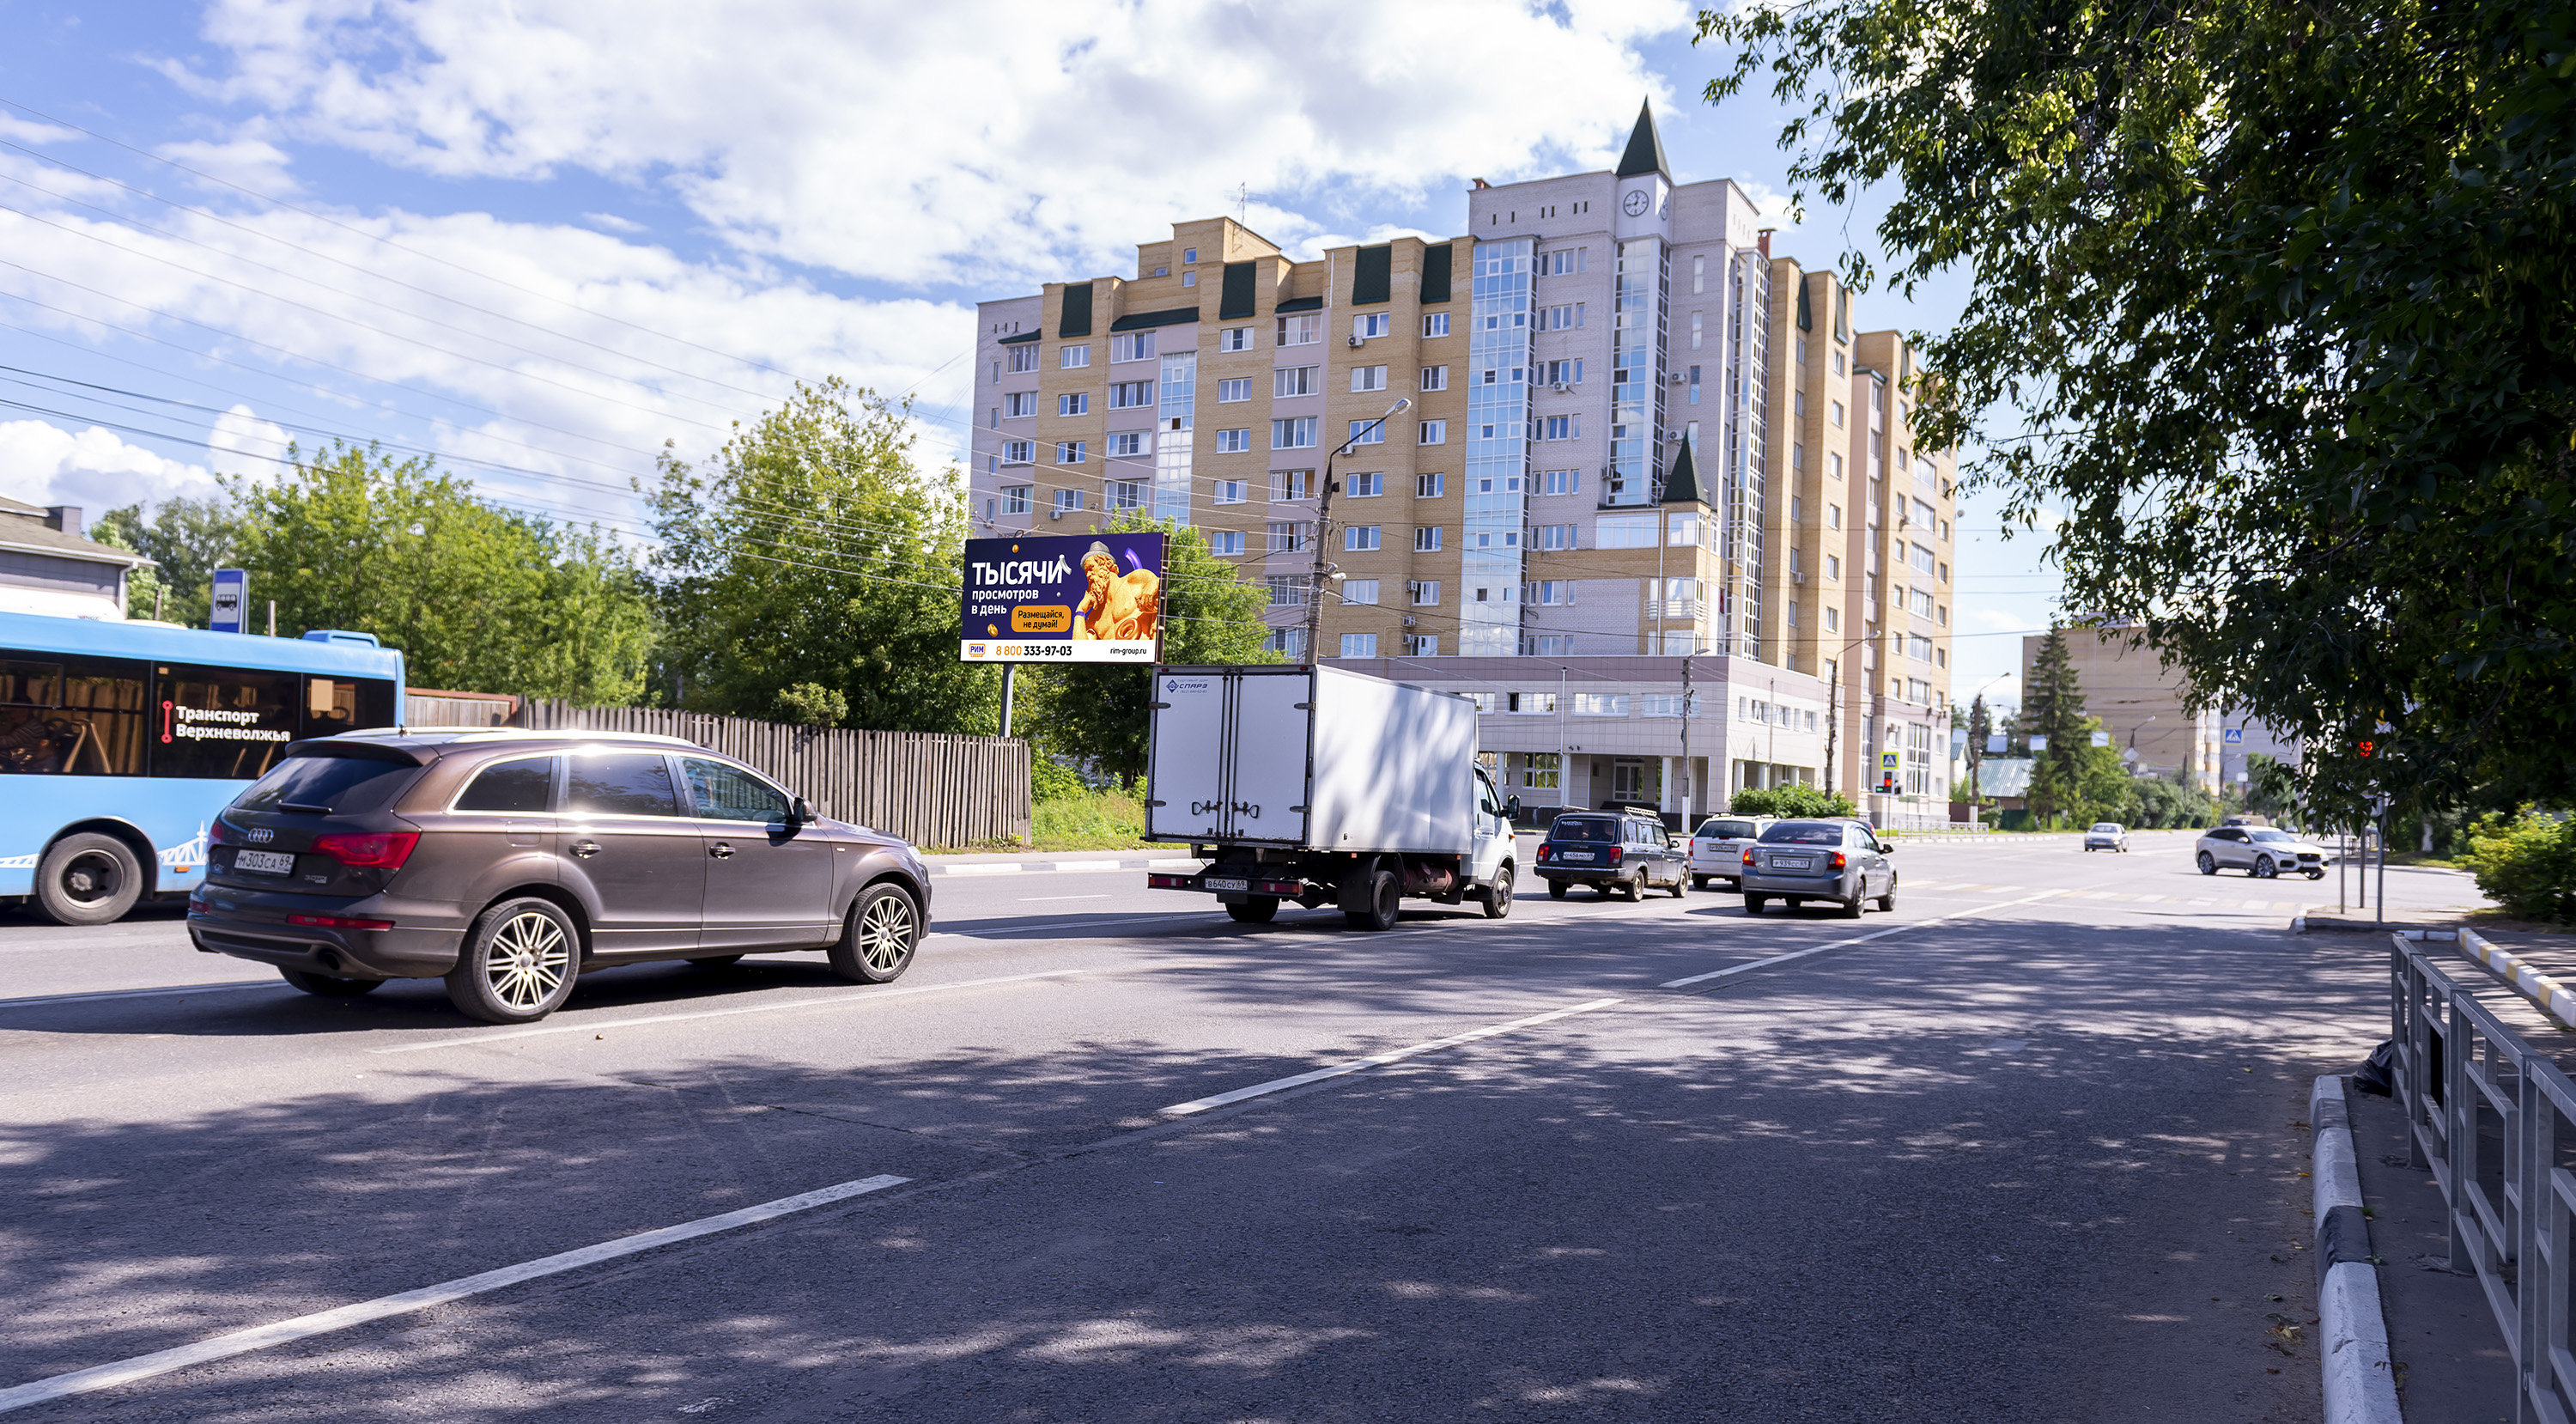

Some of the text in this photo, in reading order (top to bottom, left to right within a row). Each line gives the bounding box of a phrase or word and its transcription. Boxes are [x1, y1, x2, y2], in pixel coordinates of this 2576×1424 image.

[972, 558, 1064, 585] ТЫСЯЧИ
[972, 589, 1039, 602] просмотров
[971, 604, 1007, 616] в день
[1018, 610, 1065, 619] Размещайся,
[1033, 619, 1058, 630] думай!
[996, 645, 1072, 656] 8 800 333-97-03
[1109, 647, 1147, 656] rim-group.ru
[175, 706, 259, 726] Транспорт
[175, 723, 291, 742] Верхневолжья
